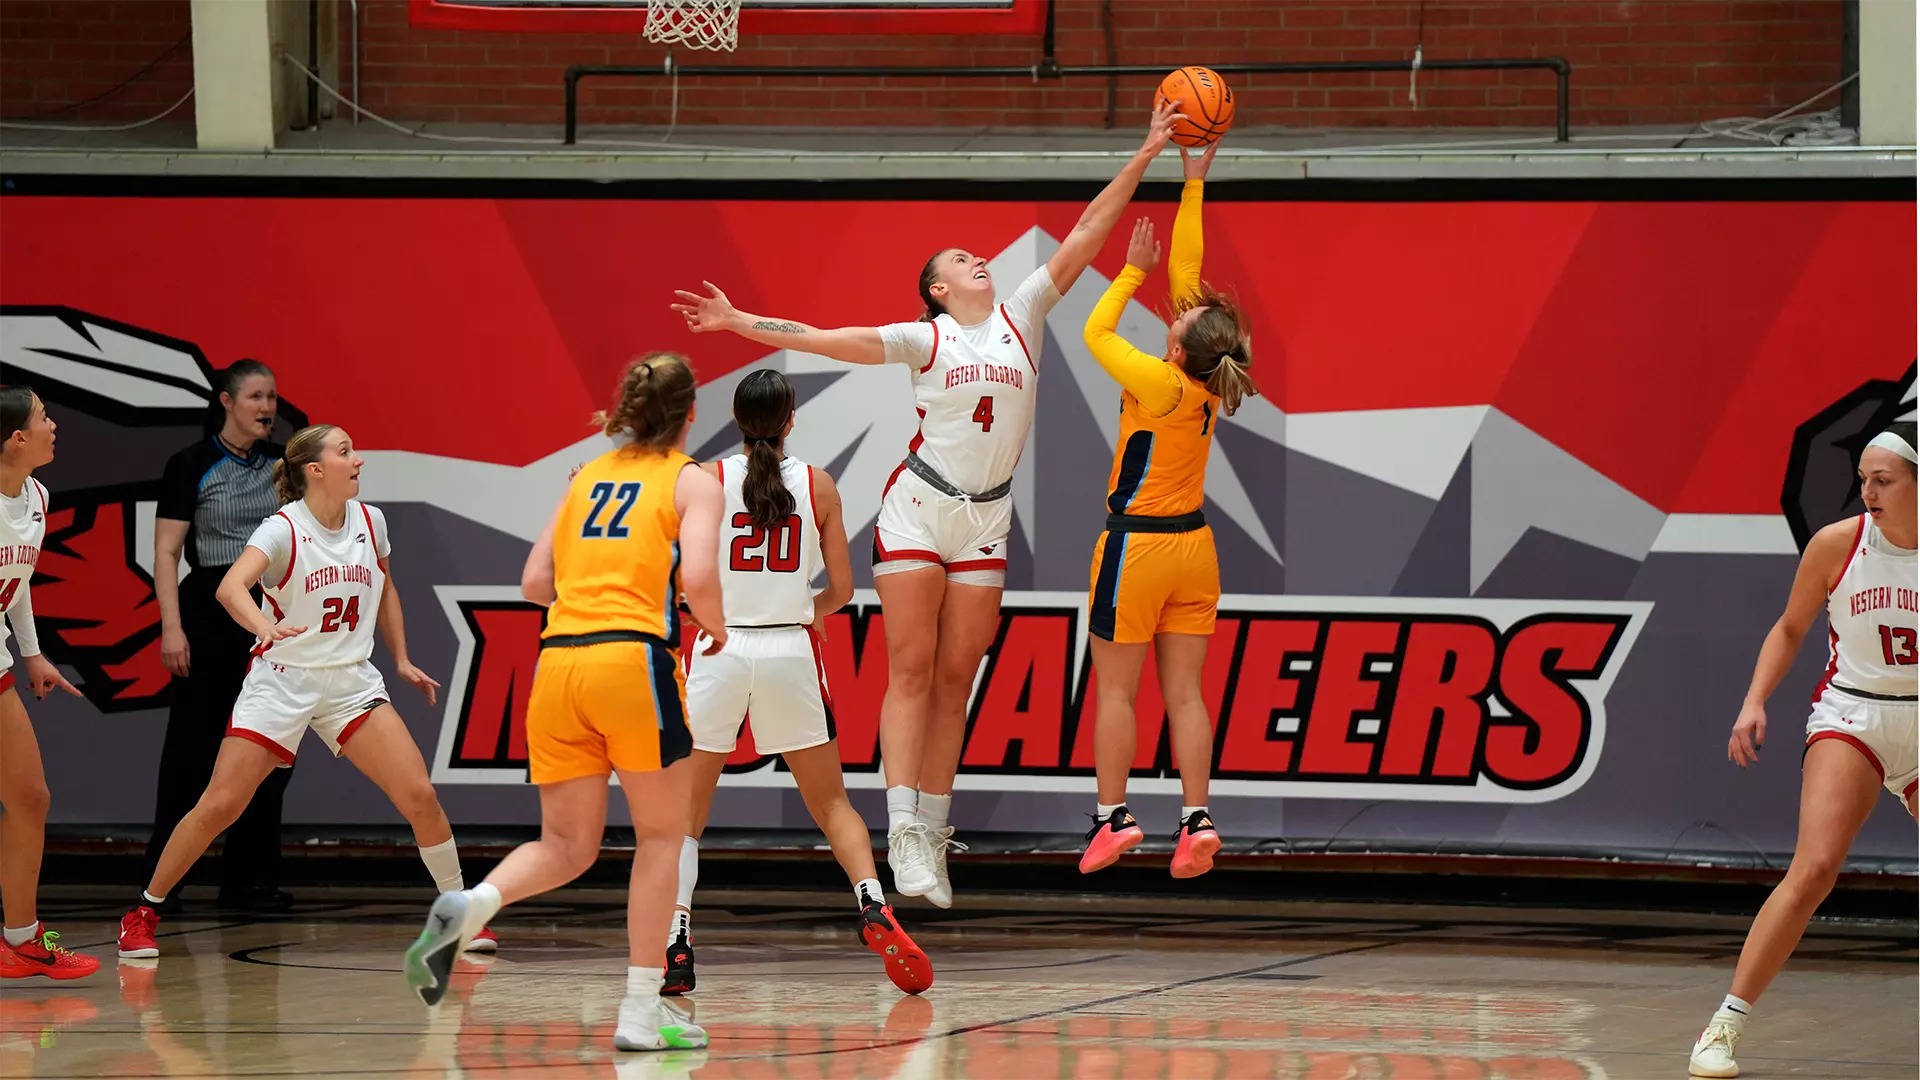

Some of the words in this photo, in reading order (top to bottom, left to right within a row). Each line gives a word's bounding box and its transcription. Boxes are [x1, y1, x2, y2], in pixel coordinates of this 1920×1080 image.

[945, 364, 980, 390] WESTERN
[984, 363, 1023, 390] COLORADO
[972, 396, 994, 432] 4
[578, 482, 642, 538] 22
[730, 511, 802, 573] 20
[305, 565, 339, 594] WESTERN
[342, 564, 372, 588] COLORADO
[320, 595, 360, 633] 24
[1850, 586, 1892, 617] WESTERN
[1878, 624, 1920, 665] 13
